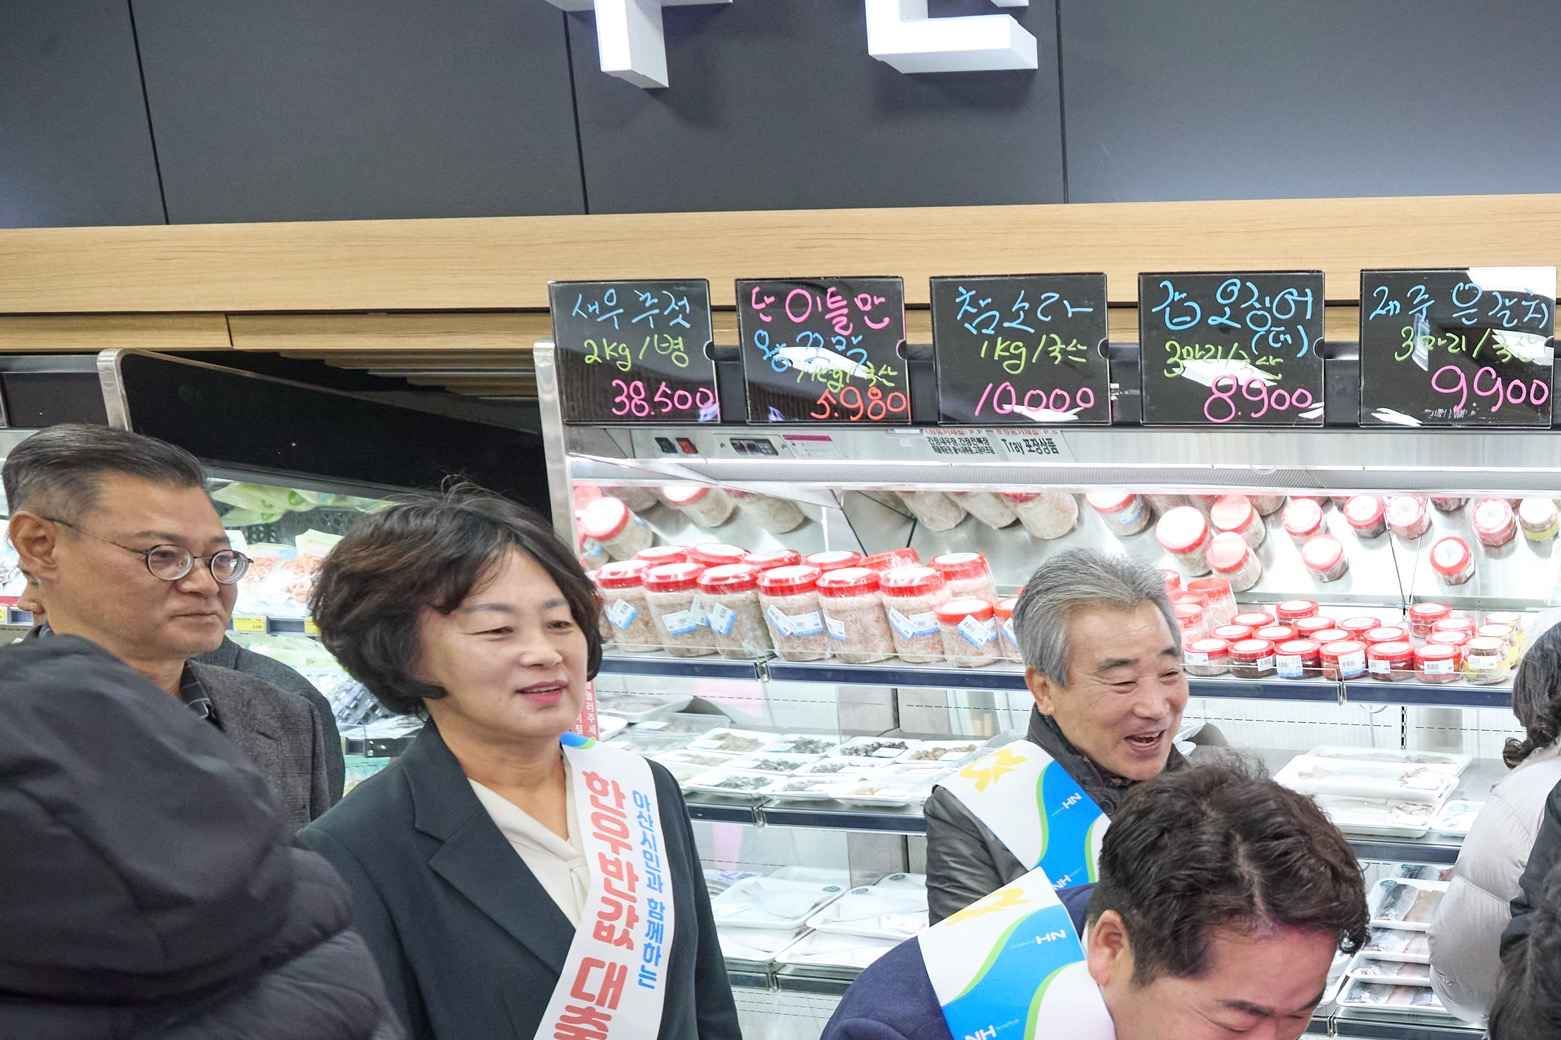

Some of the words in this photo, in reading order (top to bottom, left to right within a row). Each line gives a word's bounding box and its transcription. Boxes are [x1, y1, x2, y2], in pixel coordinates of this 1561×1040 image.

[571, 288, 624, 330] 새우
[955, 286, 1093, 335] 참소라
[1369, 285, 1435, 321] 제주
[612, 379, 713, 416] 38.500
[810, 386, 906, 421] 5.980
[582, 770, 640, 951] 한우반값
[632, 790, 663, 894] 아산시민과
[638, 898, 666, 990] 함께하는
[1035, 929, 1067, 945] NH
